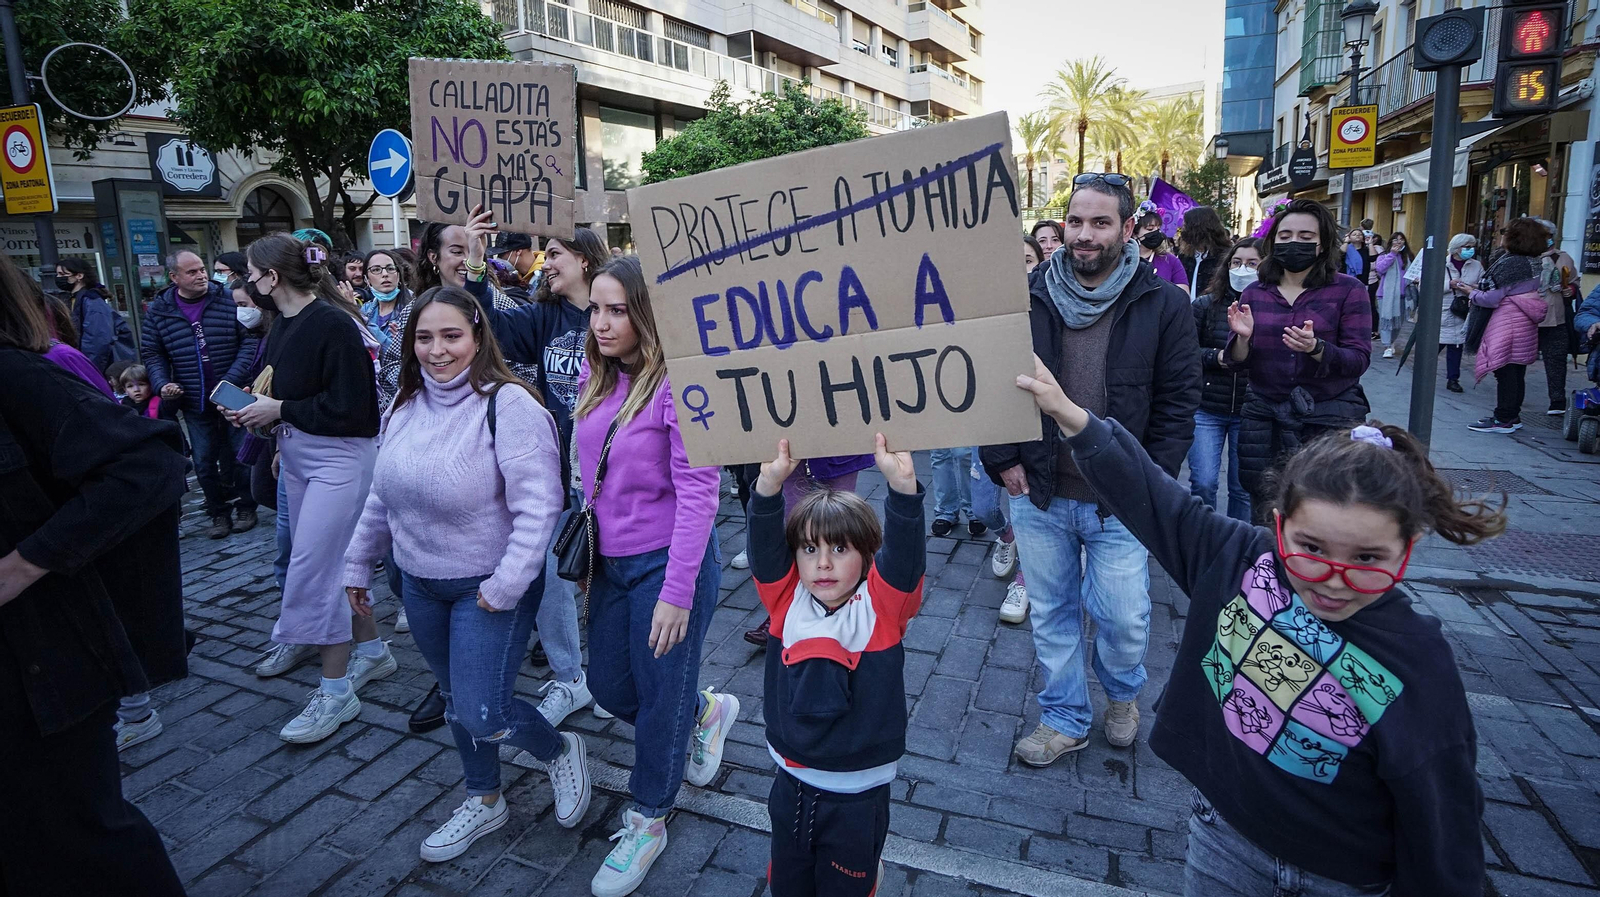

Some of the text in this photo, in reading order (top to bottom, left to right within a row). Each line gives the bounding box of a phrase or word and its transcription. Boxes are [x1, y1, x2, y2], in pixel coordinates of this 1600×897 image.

[429, 79, 550, 117] CALLADITA
[1519, 70, 1545, 100] 15
[431, 116, 561, 169] NO ESTÁS
[167, 171, 208, 181] Corredera
[497, 148, 543, 181] MÁS
[5, 178, 46, 190] ZONA PEATONAL
[434, 166, 552, 225] GUAPA
[834, 176, 858, 246] A
[862, 169, 916, 238] TU
[919, 150, 1019, 232] HIJA
[0, 227, 28, 235] Vinos
[1425, 235, 1434, 250] 1
[692, 252, 955, 357] EDUCA A
[544, 347, 585, 376] VIKIN
[716, 345, 976, 432] TU HIJO
[831, 861, 867, 878] FEARLESS
